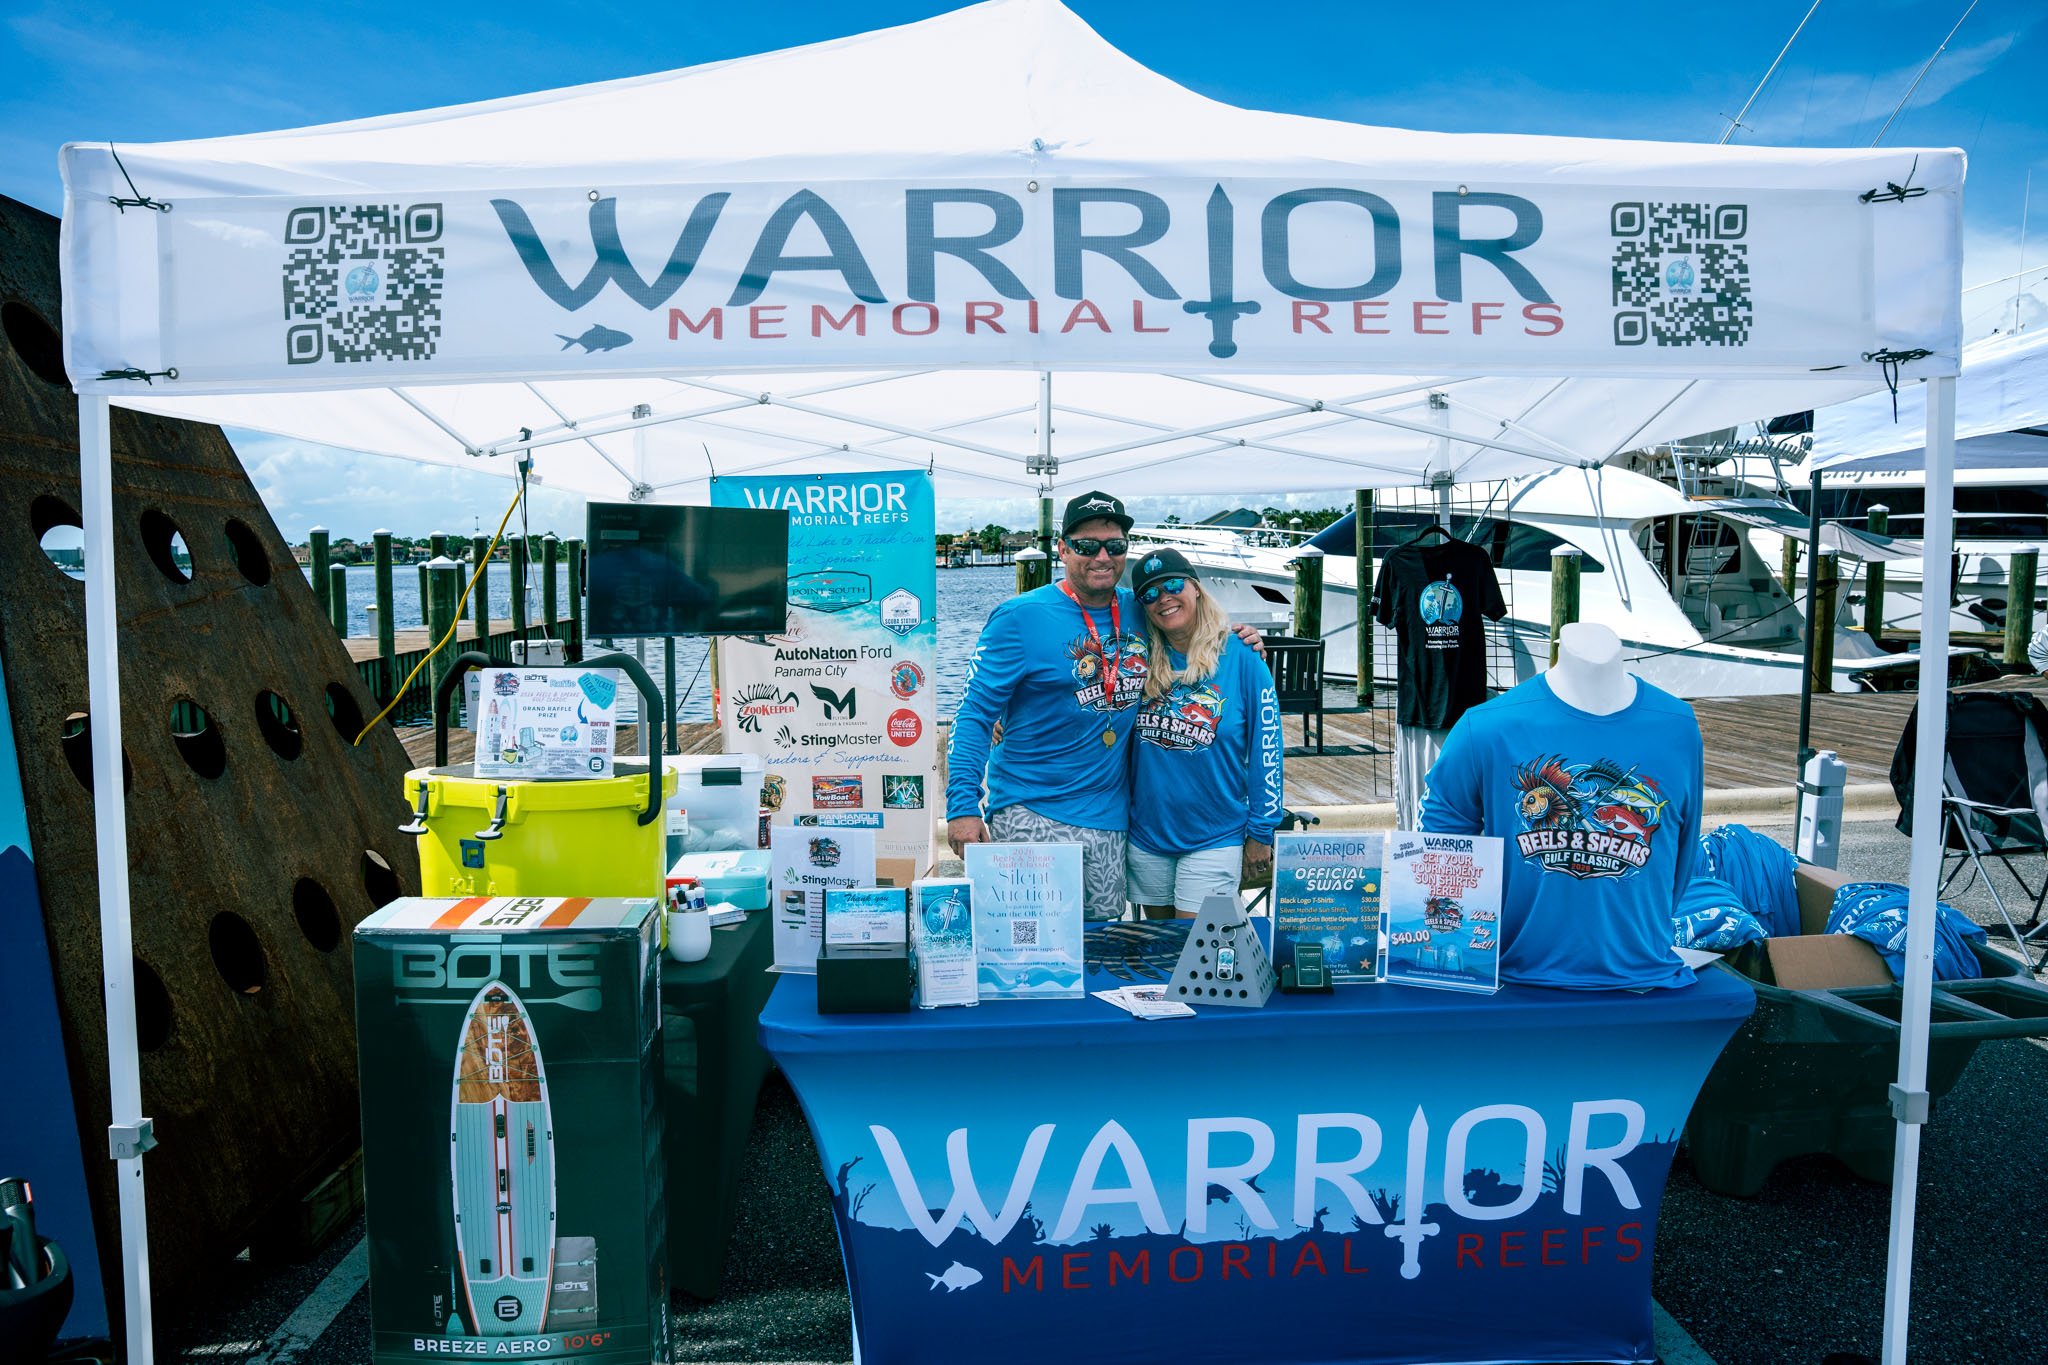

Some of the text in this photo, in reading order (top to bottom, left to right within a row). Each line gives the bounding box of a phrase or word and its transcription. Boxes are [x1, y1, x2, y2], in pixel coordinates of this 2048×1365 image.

[489, 184, 1555, 312] WARRIOR
[668, 301, 1564, 341] MEMORIAL REEFS
[744, 483, 908, 514] WARRIOR
[792, 511, 909, 526] MORIAL REEFS
[858, 533, 895, 545] Thank
[901, 531, 926, 543] Our
[792, 587, 866, 596] POINT SOUTH
[1425, 625, 1460, 634] WARRIOR
[774, 645, 892, 662] AutoNation Ford
[774, 665, 848, 678] Panama City
[582, 677, 598, 696] TICKET
[1075, 683, 1106, 706] REEL
[1136, 713, 1216, 746] EELS & SPEARS
[801, 734, 883, 747] StingMaster
[1142, 729, 1193, 747] GULF CLASSIC
[1261, 687, 1279, 817] WARRIOR
[1297, 842, 1366, 857] WARRIOR
[1424, 837, 1473, 850] WARRIOR
[1517, 831, 1651, 867] REELS & SPEARS
[1421, 853, 1473, 866] GET YOUR
[1544, 852, 1620, 871] GULF CLASSIC
[999, 868, 1049, 885] Silent
[1295, 867, 1366, 880] OFFICIAL
[1411, 862, 1484, 878] TOURNAMENT
[802, 875, 861, 887] StingMaster
[1306, 879, 1354, 892] SWAG
[1415, 873, 1478, 889] SUN SHIRTS
[844, 893, 890, 904] Thank you
[992, 885, 1063, 902] Auction
[1429, 885, 1463, 898] HERE!!
[1297, 897, 1312, 905] Logo
[1279, 916, 1307, 924] Challenge
[1470, 910, 1497, 922] While
[1390, 930, 1431, 945] $40.00
[1472, 924, 1491, 938] they
[868, 1099, 1647, 1248] WARRIOR
[1001, 1222, 1644, 1296] MEMORIAL REEFS
[413, 1338, 488, 1354] BREEZE
